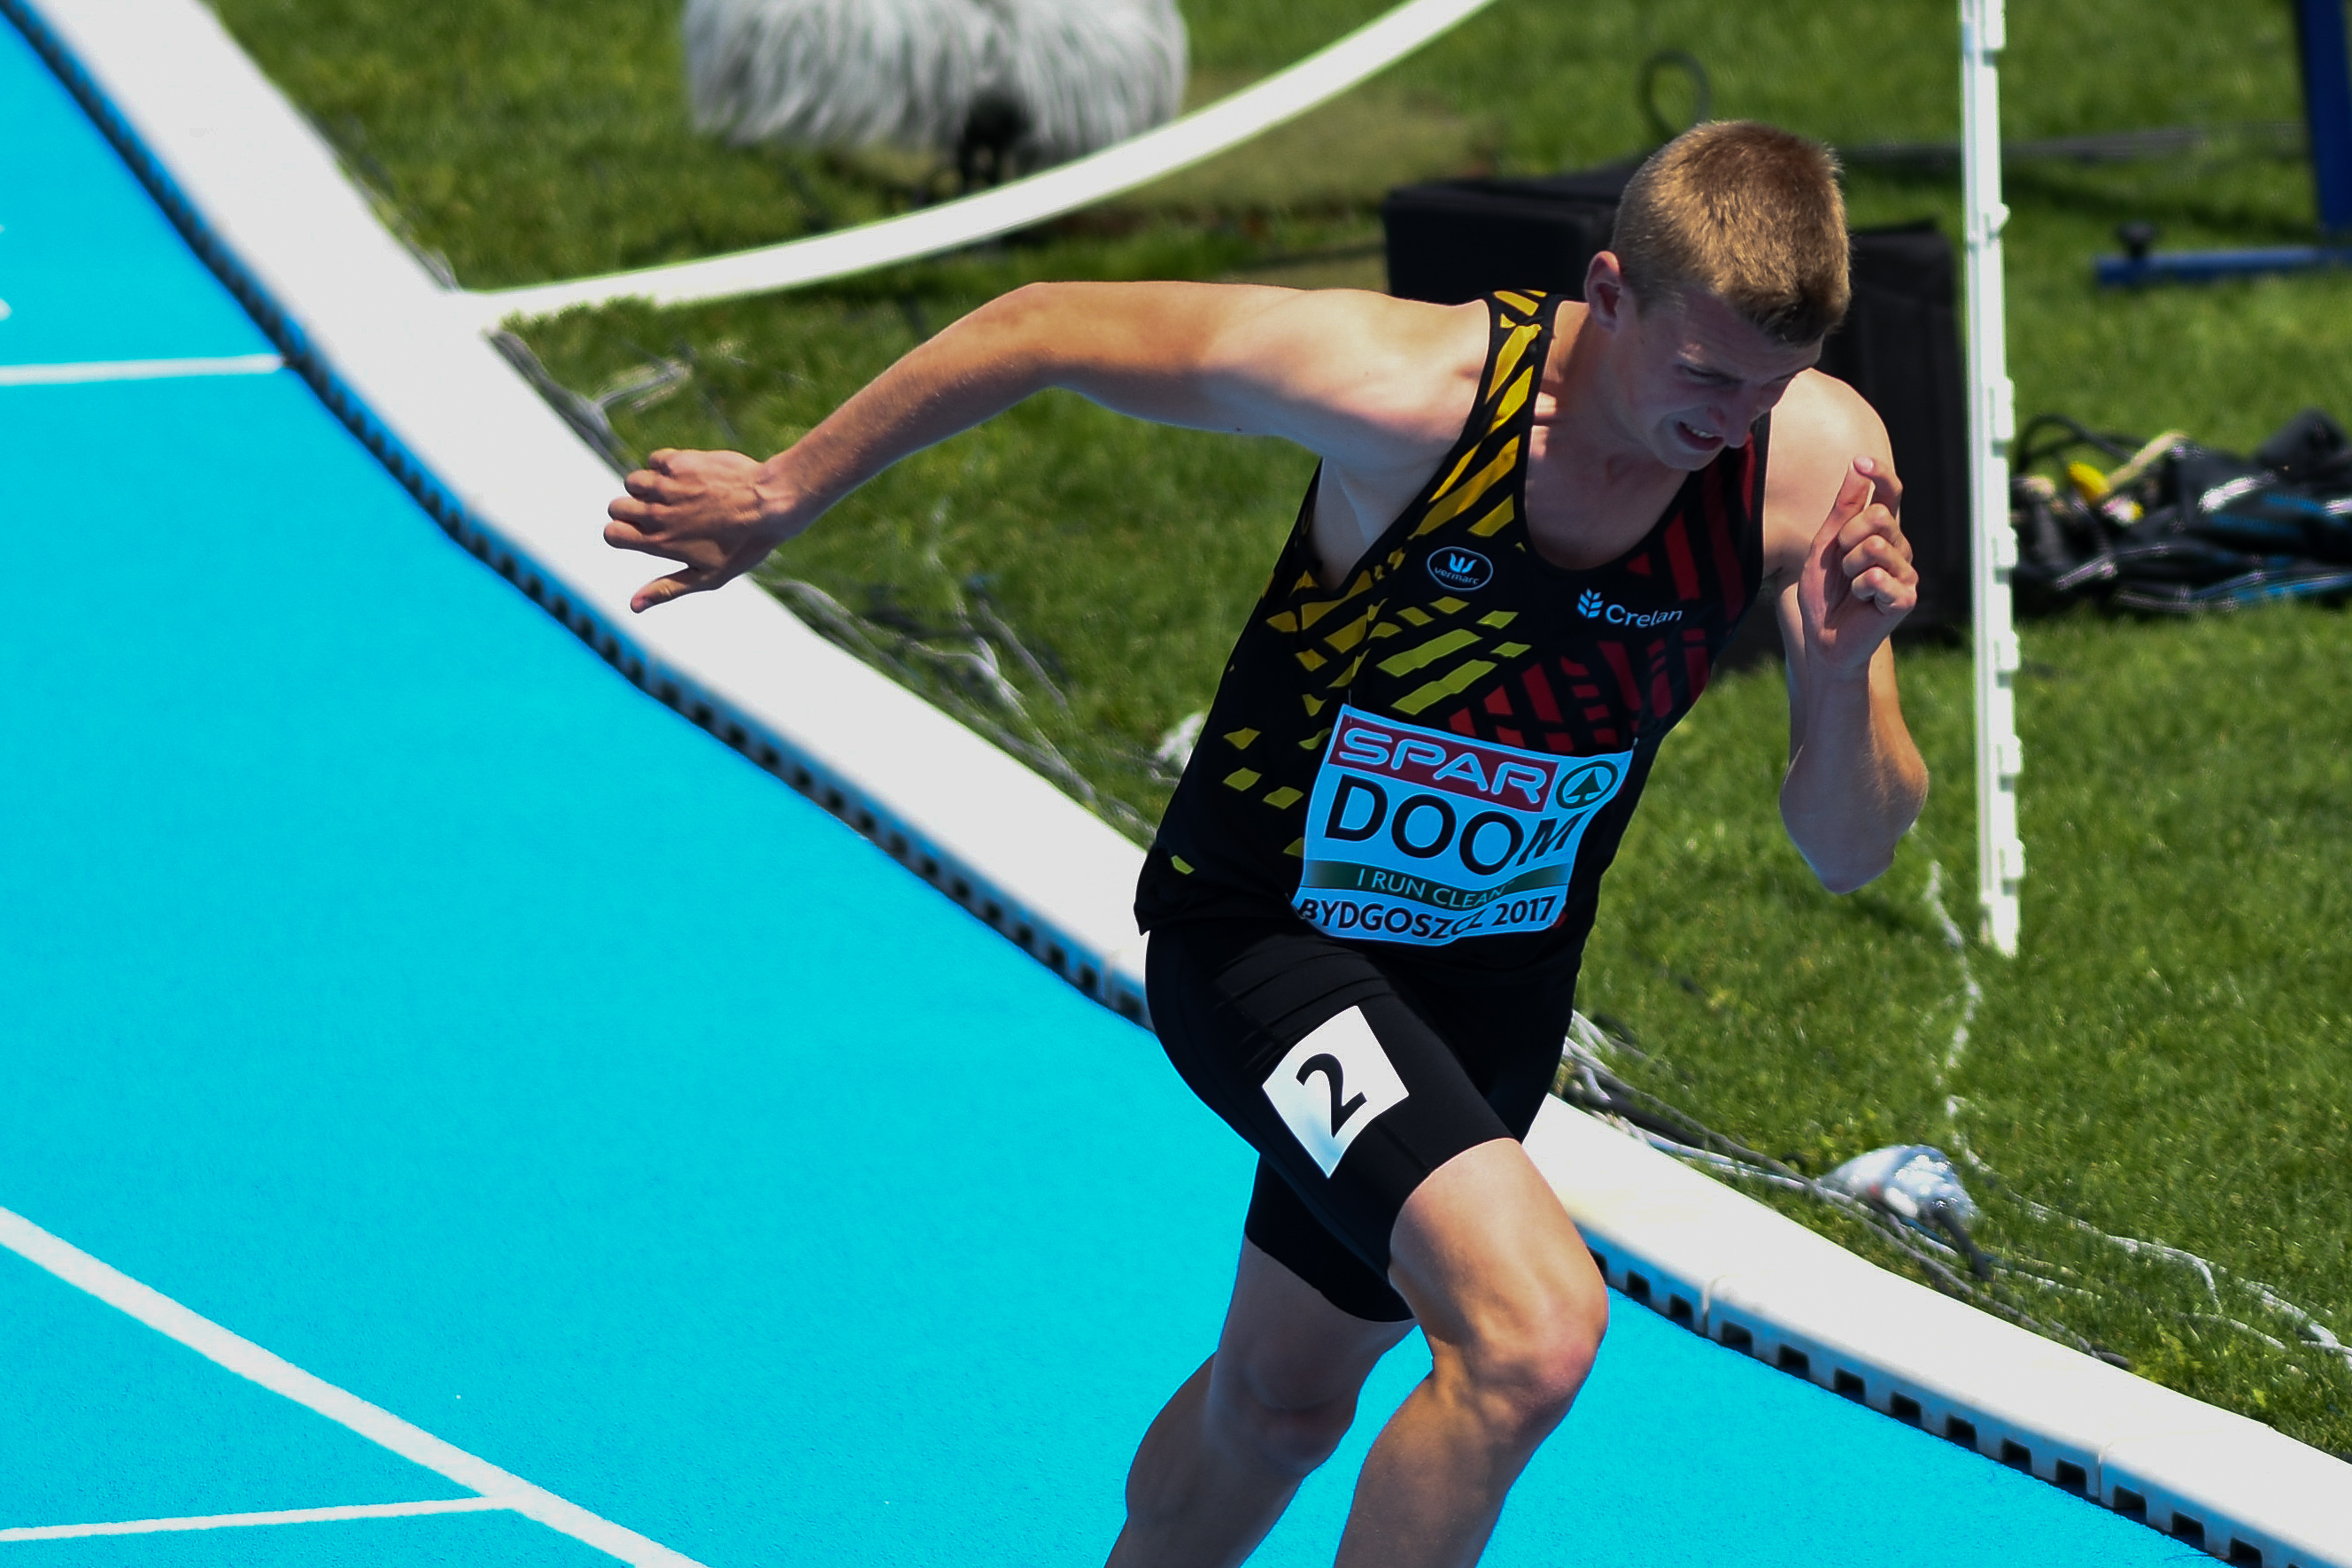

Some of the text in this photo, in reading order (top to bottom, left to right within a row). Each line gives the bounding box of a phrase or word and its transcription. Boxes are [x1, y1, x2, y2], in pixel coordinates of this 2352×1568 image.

[1434, 567, 1480, 585] vermarc
[1605, 604, 1683, 628] Crelan
[1338, 727, 1547, 804] SPAR
[1324, 773, 1590, 877] DOOM
[1358, 869, 1508, 909] I RUN CLEAN
[1298, 896, 1556, 940] BYDGOSZCZ 2017
[1296, 1053, 1368, 1139] 2
